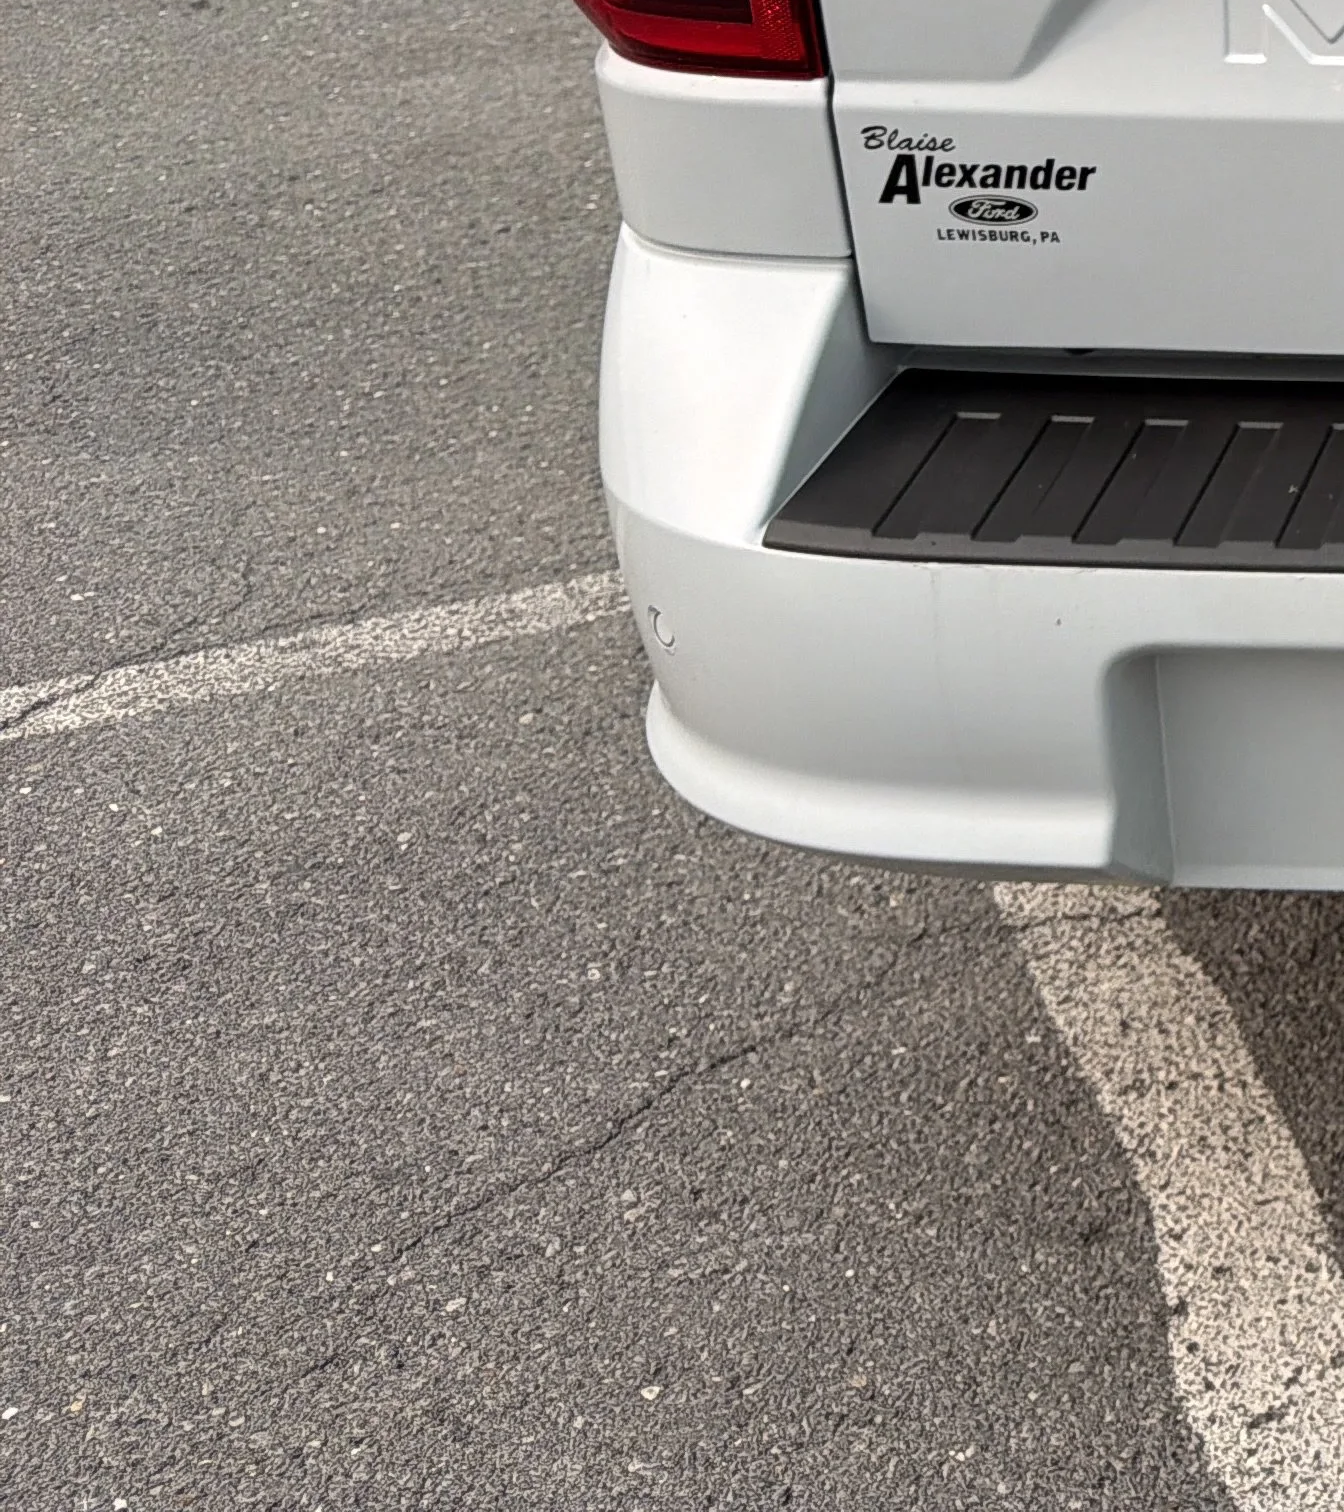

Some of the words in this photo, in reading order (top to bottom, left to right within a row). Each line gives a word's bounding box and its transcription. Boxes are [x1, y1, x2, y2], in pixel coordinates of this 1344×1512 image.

[860, 125, 956, 152] Blaise
[878, 153, 1097, 205] Alexander
[967, 199, 1021, 221] Ford
[936, 228, 1038, 245] LEWISBURG,
[1040, 230, 1061, 244] PA
